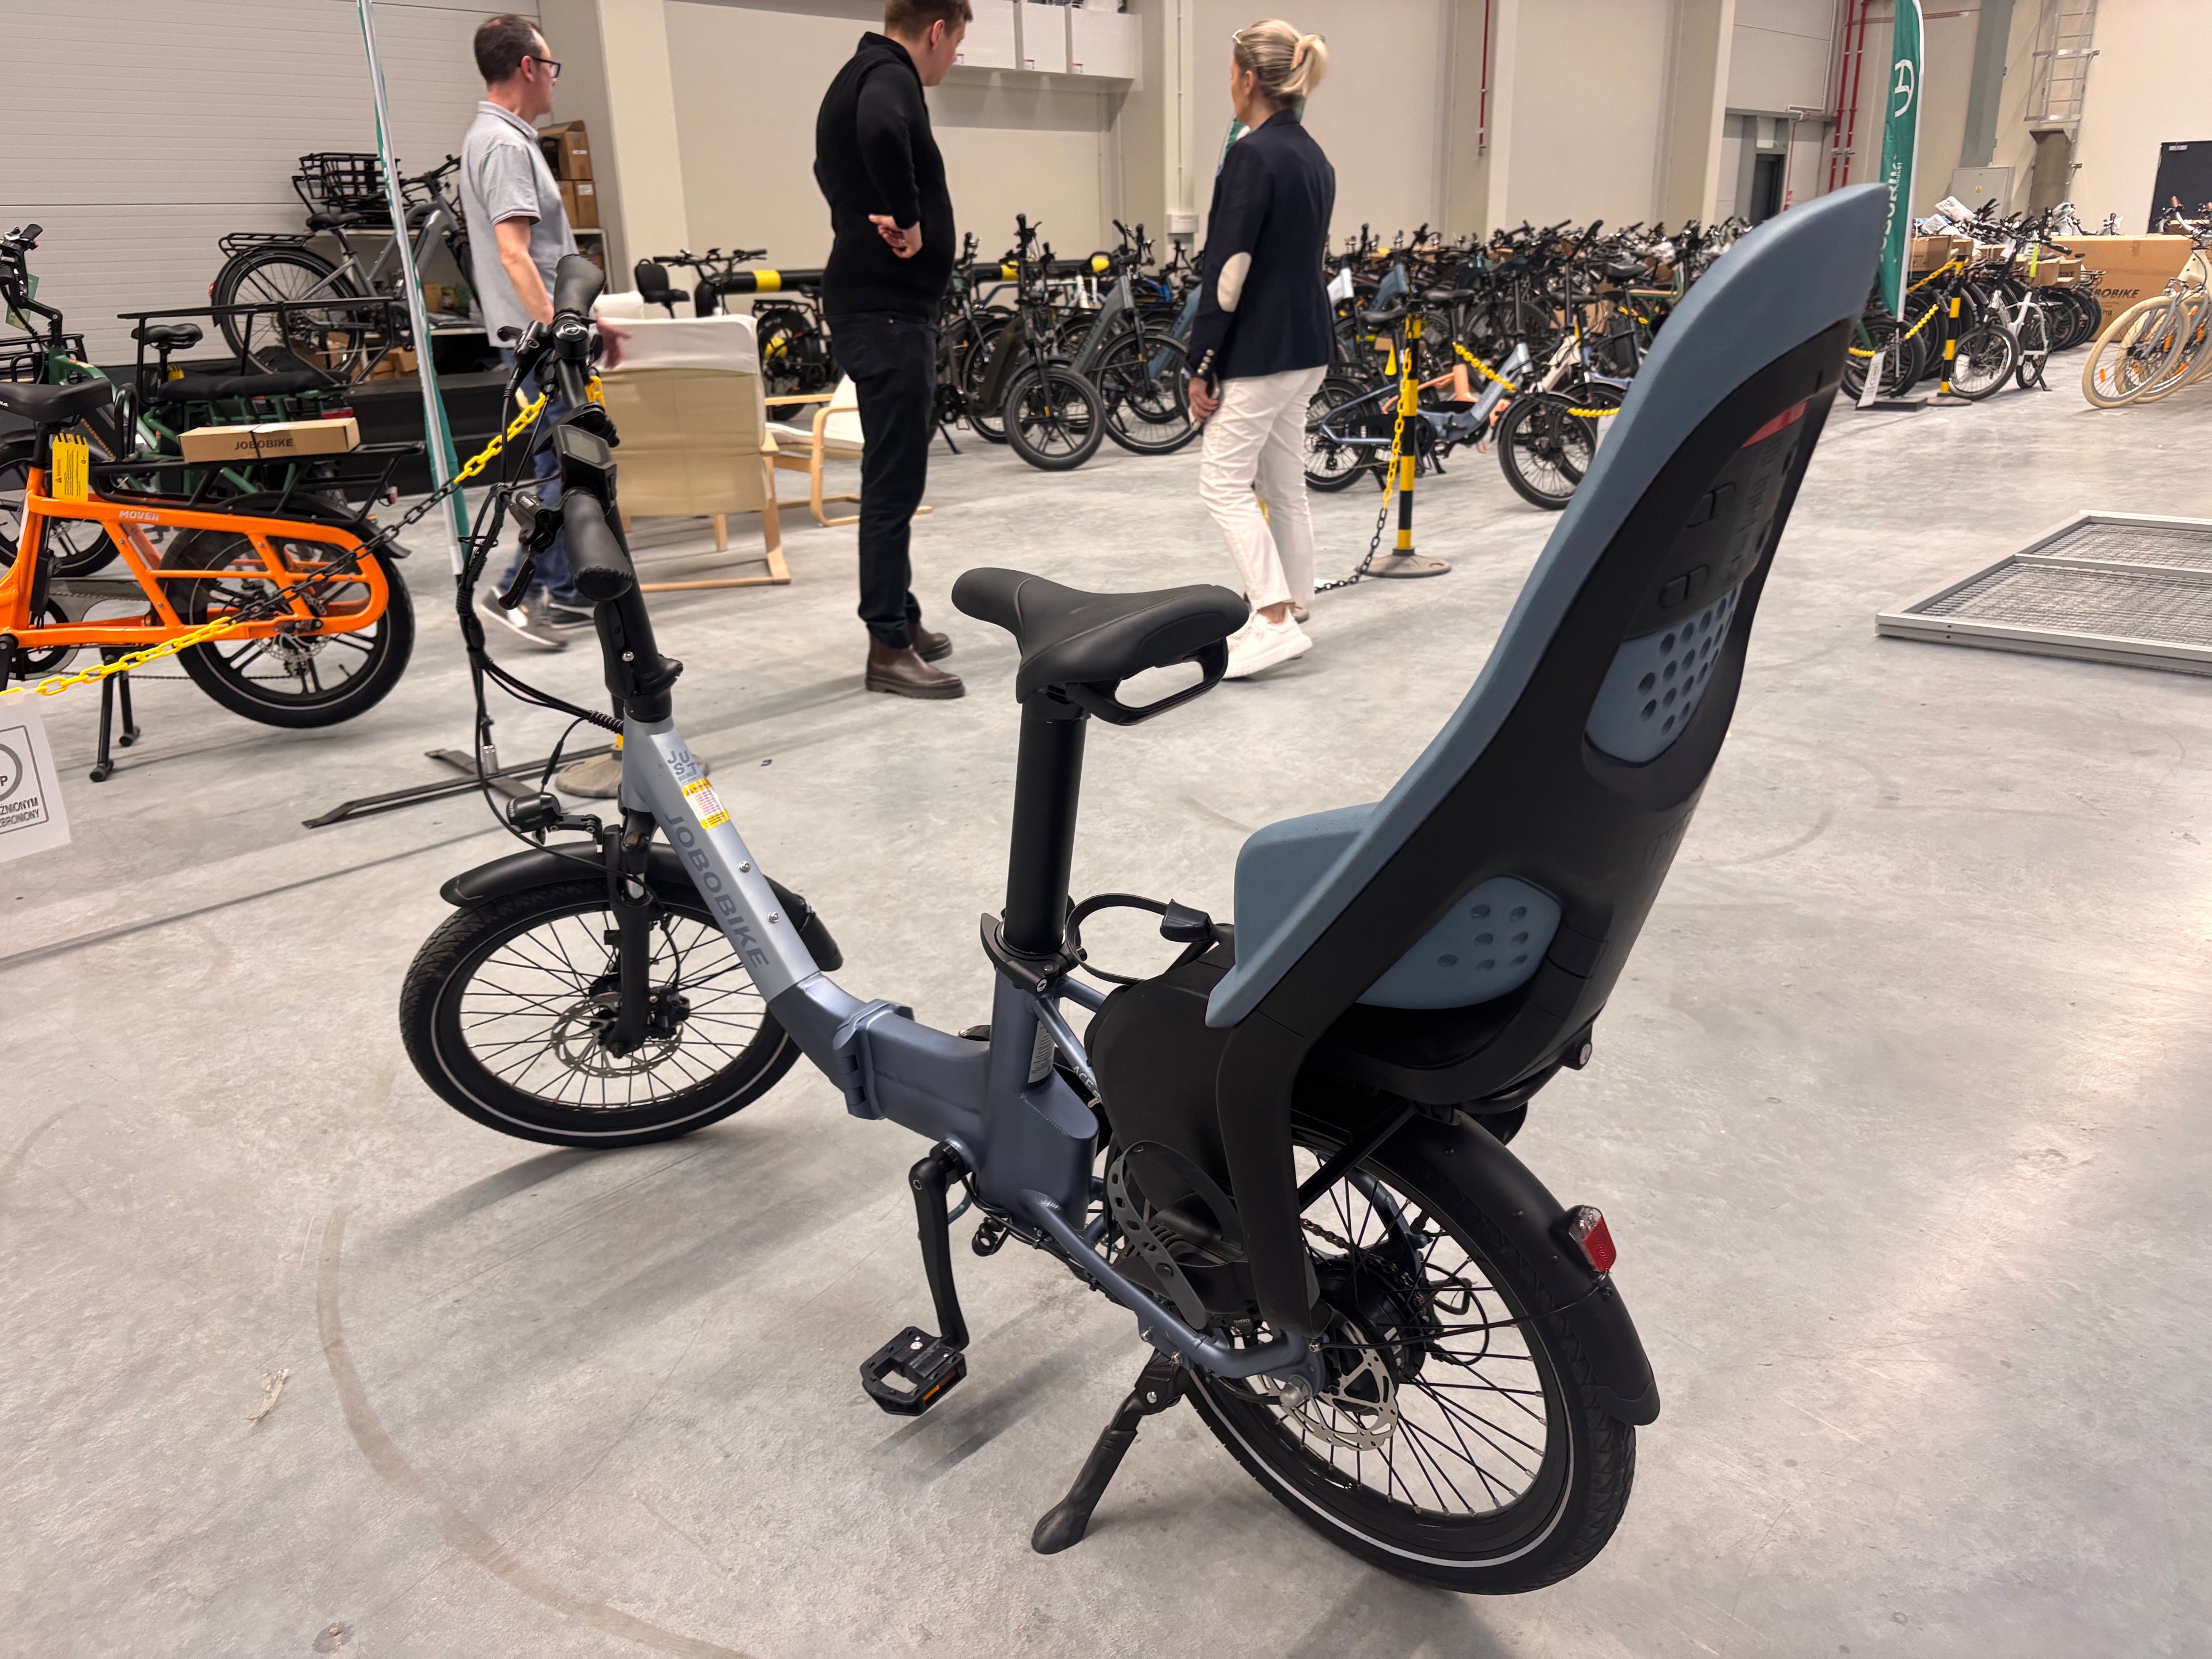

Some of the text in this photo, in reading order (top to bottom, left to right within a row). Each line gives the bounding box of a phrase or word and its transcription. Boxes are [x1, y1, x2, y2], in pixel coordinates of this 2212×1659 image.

[234, 438, 294, 450] JOBOBIKE
[119, 510, 159, 521] MOVER
[665, 815, 770, 968] JOBOBIKE
